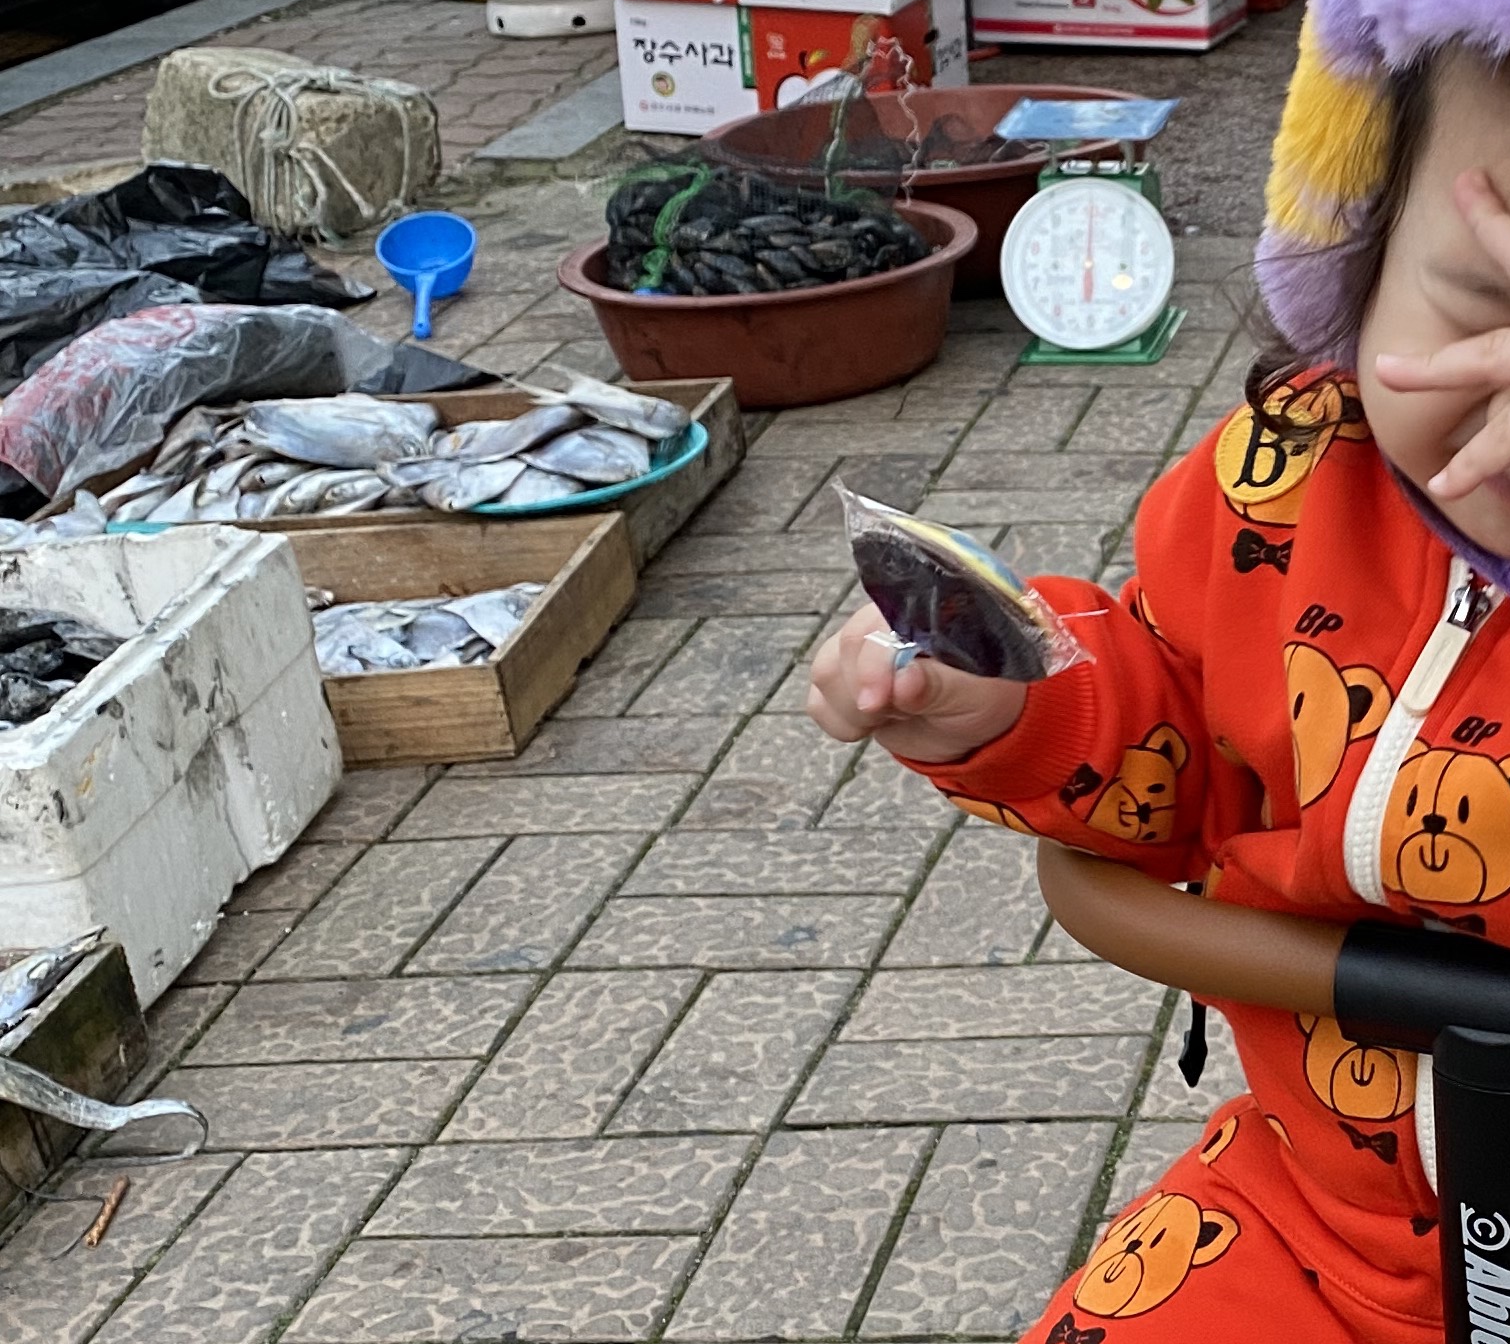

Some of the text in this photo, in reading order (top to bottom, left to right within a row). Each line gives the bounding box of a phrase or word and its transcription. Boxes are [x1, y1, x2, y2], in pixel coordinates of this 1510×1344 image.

[632, 36, 736, 70] 장수사과
[1294, 602, 1344, 638] BP
[1450, 715, 1503, 748] BP
